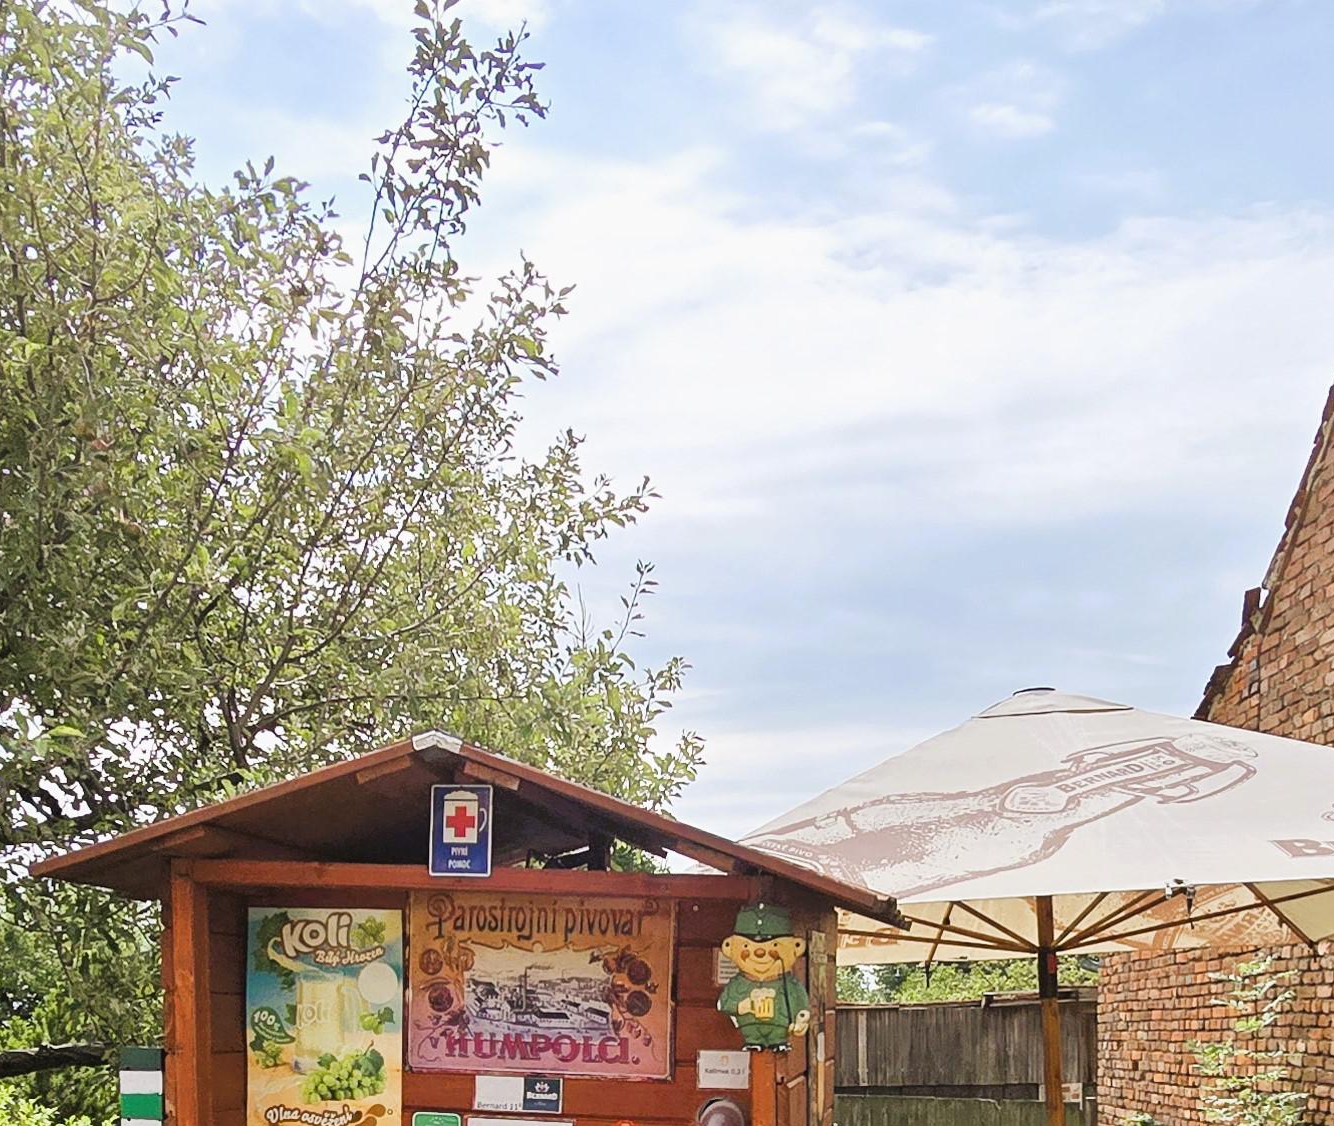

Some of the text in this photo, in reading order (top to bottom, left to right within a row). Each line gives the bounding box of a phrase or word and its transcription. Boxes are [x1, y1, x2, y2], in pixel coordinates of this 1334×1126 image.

[1056, 763, 1145, 793] BERNARD
[427, 893, 660, 942] Parostrojní pivovar
[281, 911, 353, 959] Koli
[266, 1105, 300, 1124] Vlna
[477, 1101, 508, 1110] Bernard
